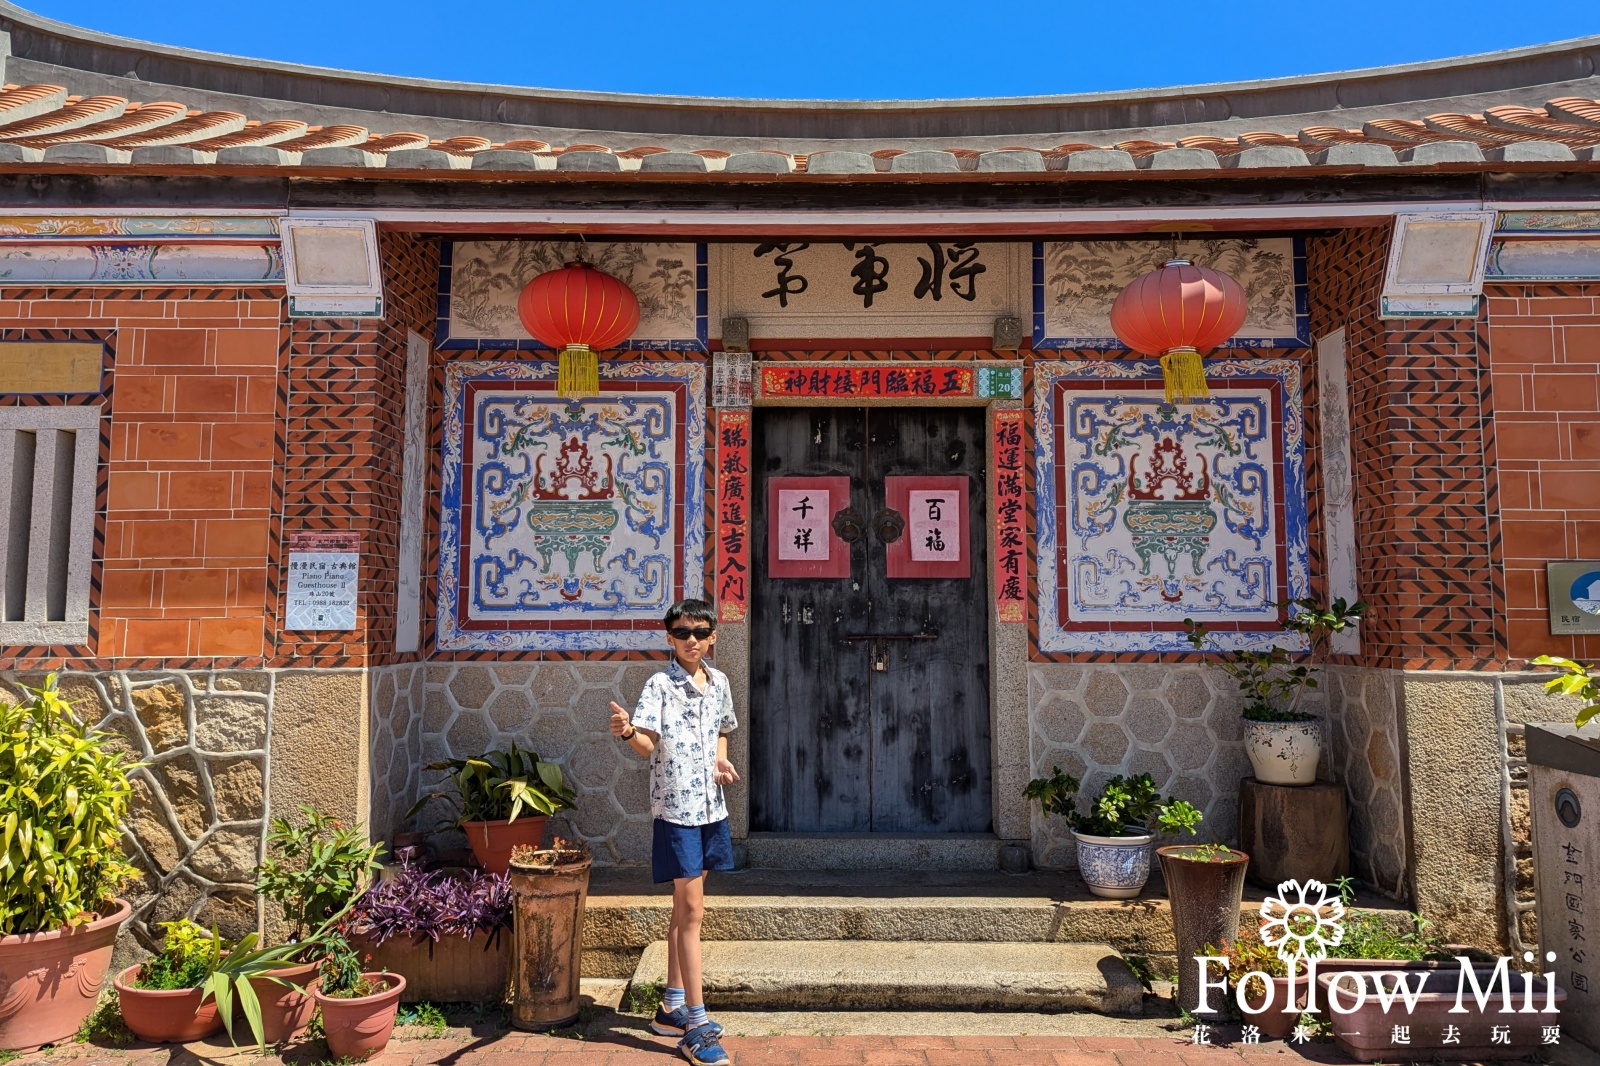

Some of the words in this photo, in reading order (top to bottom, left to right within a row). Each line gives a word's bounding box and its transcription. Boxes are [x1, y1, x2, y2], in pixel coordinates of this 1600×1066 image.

[997, 383, 1011, 393] 20
[995, 421, 1025, 601] 福運滿堂家有慶
[792, 496, 814, 553] 千祥
[924, 498, 946, 552] 百福
[302, 572, 322, 580] Piano
[324, 571, 344, 580] Piano
[297, 581, 338, 589] Guesthouse
[1561, 615, 1580, 623] 民宿
